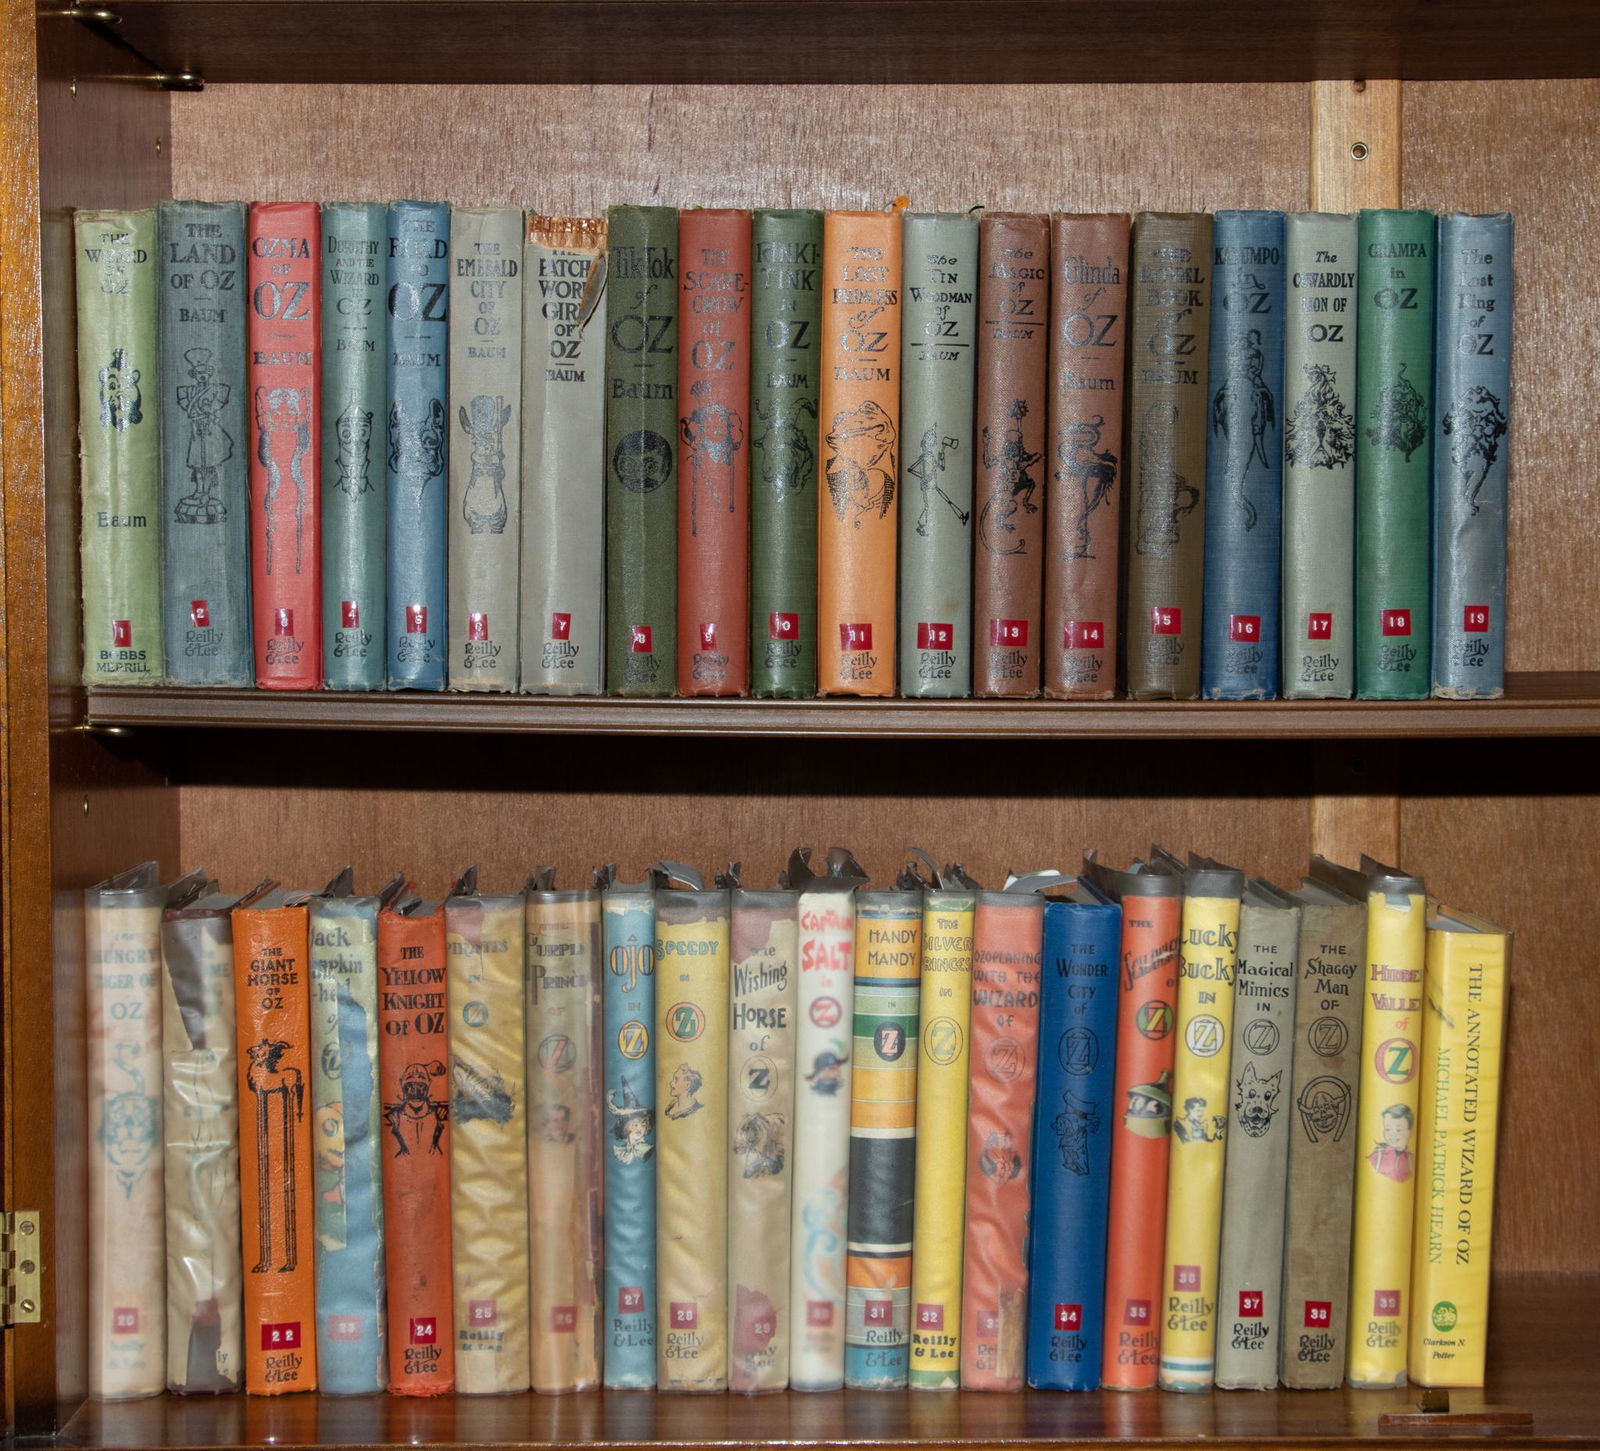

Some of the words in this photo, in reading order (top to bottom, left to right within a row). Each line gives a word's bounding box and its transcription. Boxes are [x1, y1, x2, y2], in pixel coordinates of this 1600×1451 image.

[186, 223, 223, 237] THE
[170, 243, 237, 264] LAND
[252, 237, 311, 260] OZMA
[702, 248, 730, 265] THE
[1315, 250, 1339, 264] The
[1368, 242, 1428, 259] GRAMPA
[1460, 248, 1494, 265] The
[456, 258, 518, 278] EMERALD
[927, 253, 957, 266] The
[330, 269, 380, 286] WIZARD
[928, 271, 958, 284] TIN
[989, 265, 1045, 281] MAGIC
[1065, 255, 1121, 286] Glinda
[1389, 266, 1407, 280] in
[170, 273, 194, 289] OF
[201, 269, 236, 291] OZ
[1293, 272, 1356, 290] COWARDLY
[470, 280, 508, 298] CITY
[832, 288, 898, 305] PRINCESS
[910, 287, 973, 305] WOODMAN
[253, 281, 312, 321] OZ
[336, 298, 372, 315] OZ
[387, 282, 448, 323] OZ
[998, 298, 1035, 316] OZ
[1145, 289, 1205, 308] BOOK
[1223, 292, 1273, 314] OZ
[1301, 296, 1329, 313] LION
[1333, 297, 1349, 313] OF
[1374, 287, 1418, 311] OZ
[1457, 292, 1496, 313] King
[180, 308, 226, 323] BAUM
[935, 304, 950, 321] of
[474, 317, 501, 335] OZ
[554, 323, 576, 337] OF
[611, 315, 674, 354] OZ
[764, 320, 811, 349] OZ
[923, 320, 960, 337] OZ
[1063, 313, 1119, 348] OZ
[1309, 324, 1345, 343] OZ
[336, 338, 376, 352] BAUM
[550, 340, 582, 359] OZ
[840, 329, 889, 353] OZ
[1146, 334, 1197, 357] OZ
[1457, 333, 1495, 357] OZ
[253, 351, 313, 366] BAUM
[690, 340, 735, 371] OZ
[919, 350, 961, 362] BAUM
[545, 369, 586, 382] BAUM
[834, 367, 891, 382] BAUM
[1063, 371, 1117, 392] Baum
[612, 379, 673, 400] Baum
[196, 607, 205, 619] 2
[347, 610, 356, 620] 4
[1155, 614, 1172, 627] 15
[1469, 612, 1485, 624] 19
[558, 620, 567, 631] 7
[775, 619, 792, 632] 10
[1237, 621, 1254, 635] 16
[1311, 620, 1328, 632] 17
[1388, 616, 1406, 628] 18
[119, 626, 125, 638] 1
[186, 629, 224, 644] Reilly
[637, 632, 646, 644] 8
[849, 631, 865, 643] 11
[929, 630, 947, 642] 12
[1002, 626, 1020, 638] 13
[1082, 628, 1099, 641] 14
[464, 640, 502, 657] Reilly
[543, 641, 580, 657] Reilly
[1380, 644, 1417, 661] Reilly
[1455, 638, 1490, 655] Reilly
[96, 661, 151, 673] MERRILL
[920, 650, 956, 668] Reilly
[992, 650, 1029, 667] Reilly
[1302, 653, 1339, 670] Reilly
[868, 928, 918, 945] HANDY
[261, 947, 283, 958] THE
[399, 945, 425, 960] THE
[801, 938, 853, 972] SALT
[1070, 943, 1097, 956] THE
[1253, 944, 1280, 955] THE
[1319, 944, 1348, 956] THE
[250, 958, 296, 974] GIANT
[867, 950, 917, 967] MANDY
[380, 967, 447, 986] YELLOW
[1056, 957, 1109, 979] WONDER
[1237, 958, 1295, 979] Magical
[1303, 956, 1358, 980] Shaggy
[247, 973, 299, 988] HORSE
[733, 961, 788, 998] Wishing
[1467, 963, 1483, 1003] THE
[1238, 978, 1291, 999] Mimics
[1314, 979, 1350, 998] Man
[261, 997, 284, 1011] OZ
[383, 992, 445, 1011] KNIGHT
[972, 990, 1039, 1010] WIZARD
[1198, 991, 1217, 1005] IN
[1319, 998, 1342, 1012] OF
[110, 1001, 145, 1020] OZ
[1073, 1002, 1088, 1017] of
[1256, 1002, 1272, 1013] IN
[385, 1020, 411, 1036] OF
[414, 1012, 445, 1035] OZ
[733, 1002, 787, 1031] HORSE
[748, 1034, 770, 1053] of
[1463, 1008, 1482, 1123] ANNOTATED
[1434, 1047, 1452, 1126] MICHAEL
[1430, 1129, 1448, 1199] PATRICK
[1459, 1128, 1477, 1205] WIZARD
[1457, 1209, 1473, 1236] OF
[1427, 1206, 1445, 1265] HEARN
[1455, 1238, 1471, 1266] OZ
[624, 1294, 642, 1306] 27
[1168, 1296, 1216, 1316] Reilly
[1243, 1297, 1261, 1310] 37
[1378, 1296, 1397, 1310] 39
[474, 1307, 493, 1319] 25
[677, 1309, 694, 1322] 28
[869, 1307, 886, 1319] 31
[921, 1311, 938, 1324] 32
[1060, 1310, 1078, 1323] 34
[1129, 1306, 1147, 1319] 35
[1309, 1307, 1328, 1321] 38
[416, 1324, 434, 1338] 24
[613, 1318, 655, 1335] Reilly
[754, 1322, 772, 1335] 29
[1233, 1320, 1271, 1340] Reilly
[271, 1329, 294, 1343] 22
[667, 1330, 705, 1349] Reilly
[865, 1329, 904, 1347] Reilly
[912, 1333, 958, 1348] Reilly
[1051, 1334, 1089, 1352] Reilly
[1298, 1332, 1336, 1351] Reilly
[1422, 1337, 1457, 1347] Clarkson
[265, 1351, 303, 1369] Reilly
[403, 1344, 443, 1363] Reilly
[914, 1348, 926, 1359] &
[930, 1348, 955, 1360] Lee
[1431, 1351, 1456, 1361] Potter
